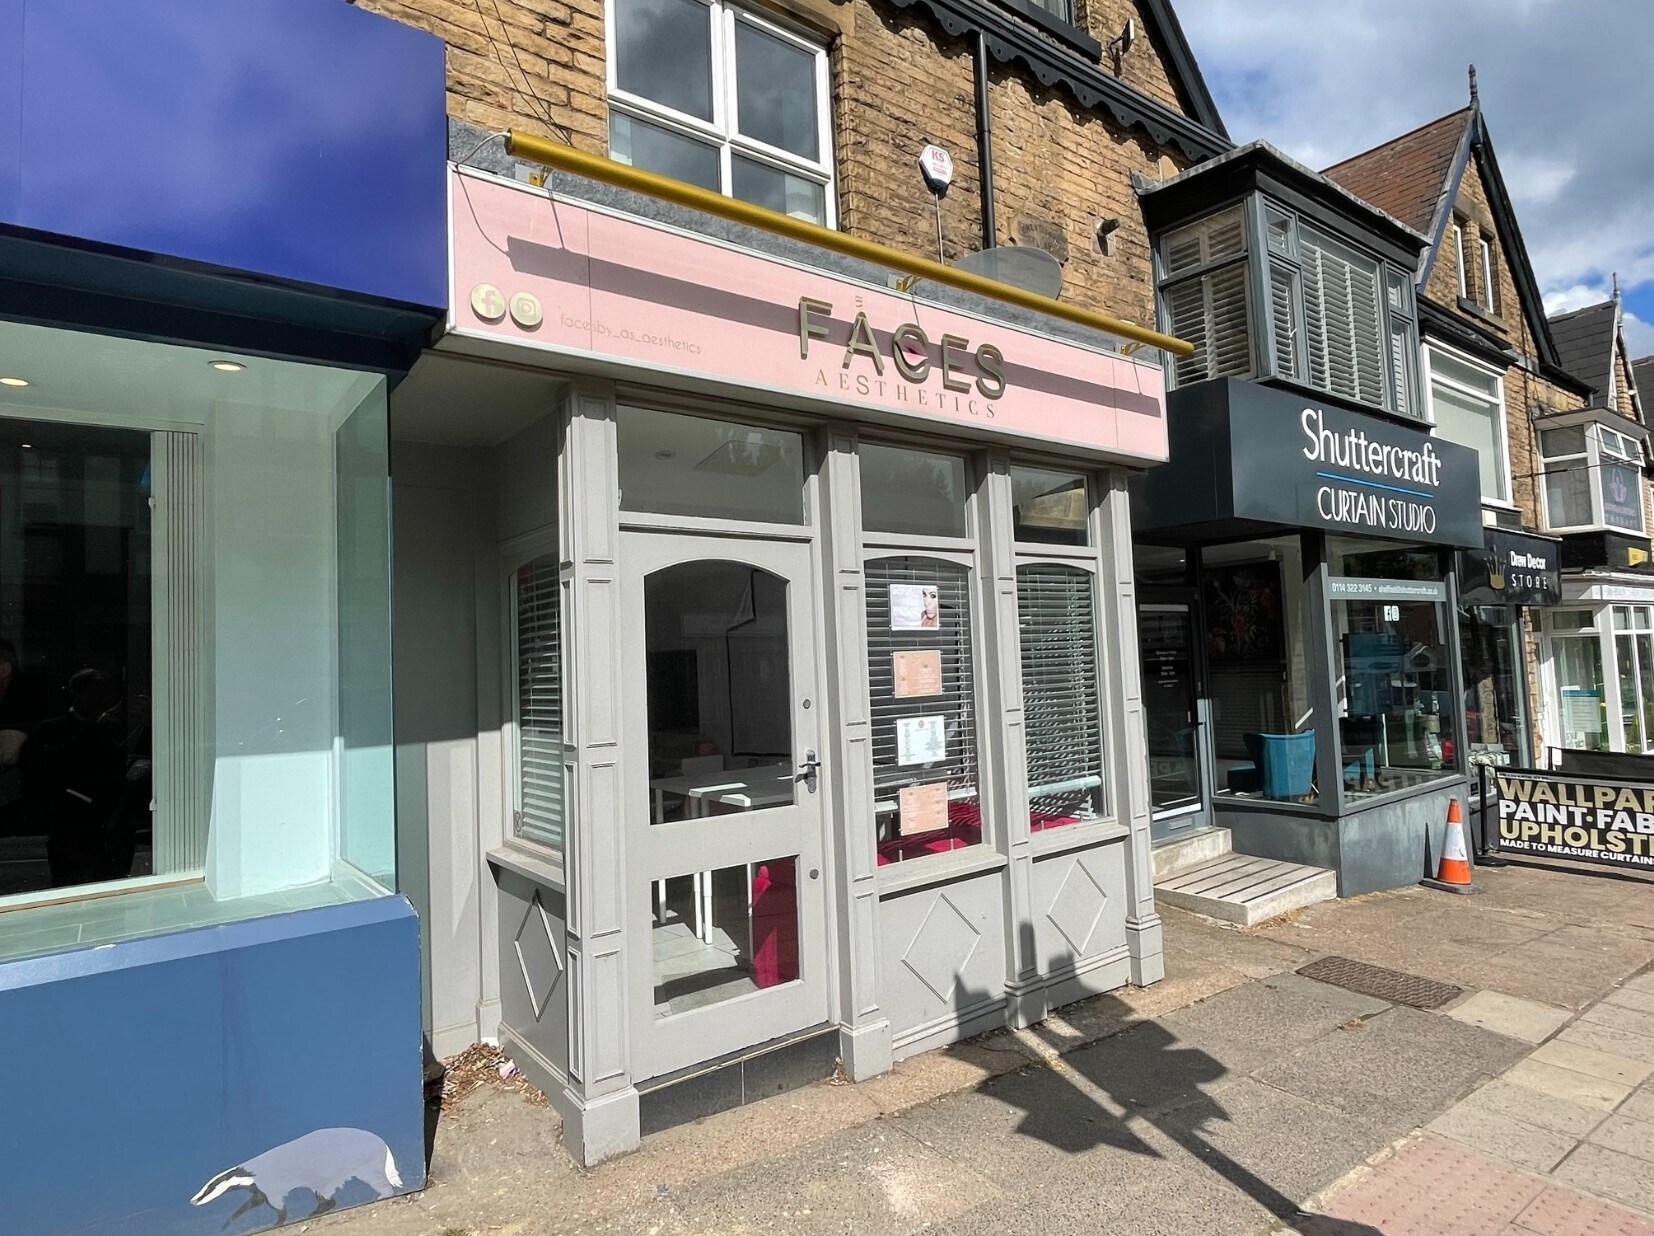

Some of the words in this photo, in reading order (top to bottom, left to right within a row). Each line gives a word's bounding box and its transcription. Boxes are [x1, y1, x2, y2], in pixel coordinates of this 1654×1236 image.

[932, 150, 945, 163] KS
[799, 296, 1006, 400] FACES
[815, 368, 995, 419] AESTHETICS
[1301, 408, 1441, 487] Shuttercraft
[1317, 486, 1386, 528] CURTAIN
[1389, 499, 1436, 534] STUDIO
[1510, 550, 1526, 568] Drew
[1526, 553, 1546, 570] Decor
[1511, 574, 1548, 590] STORE
[1499, 819, 1654, 857] UPHOLST
[1500, 838, 1530, 849] MADE
[1531, 842, 1546, 851] TO
[1547, 844, 1599, 858] MEASURE
